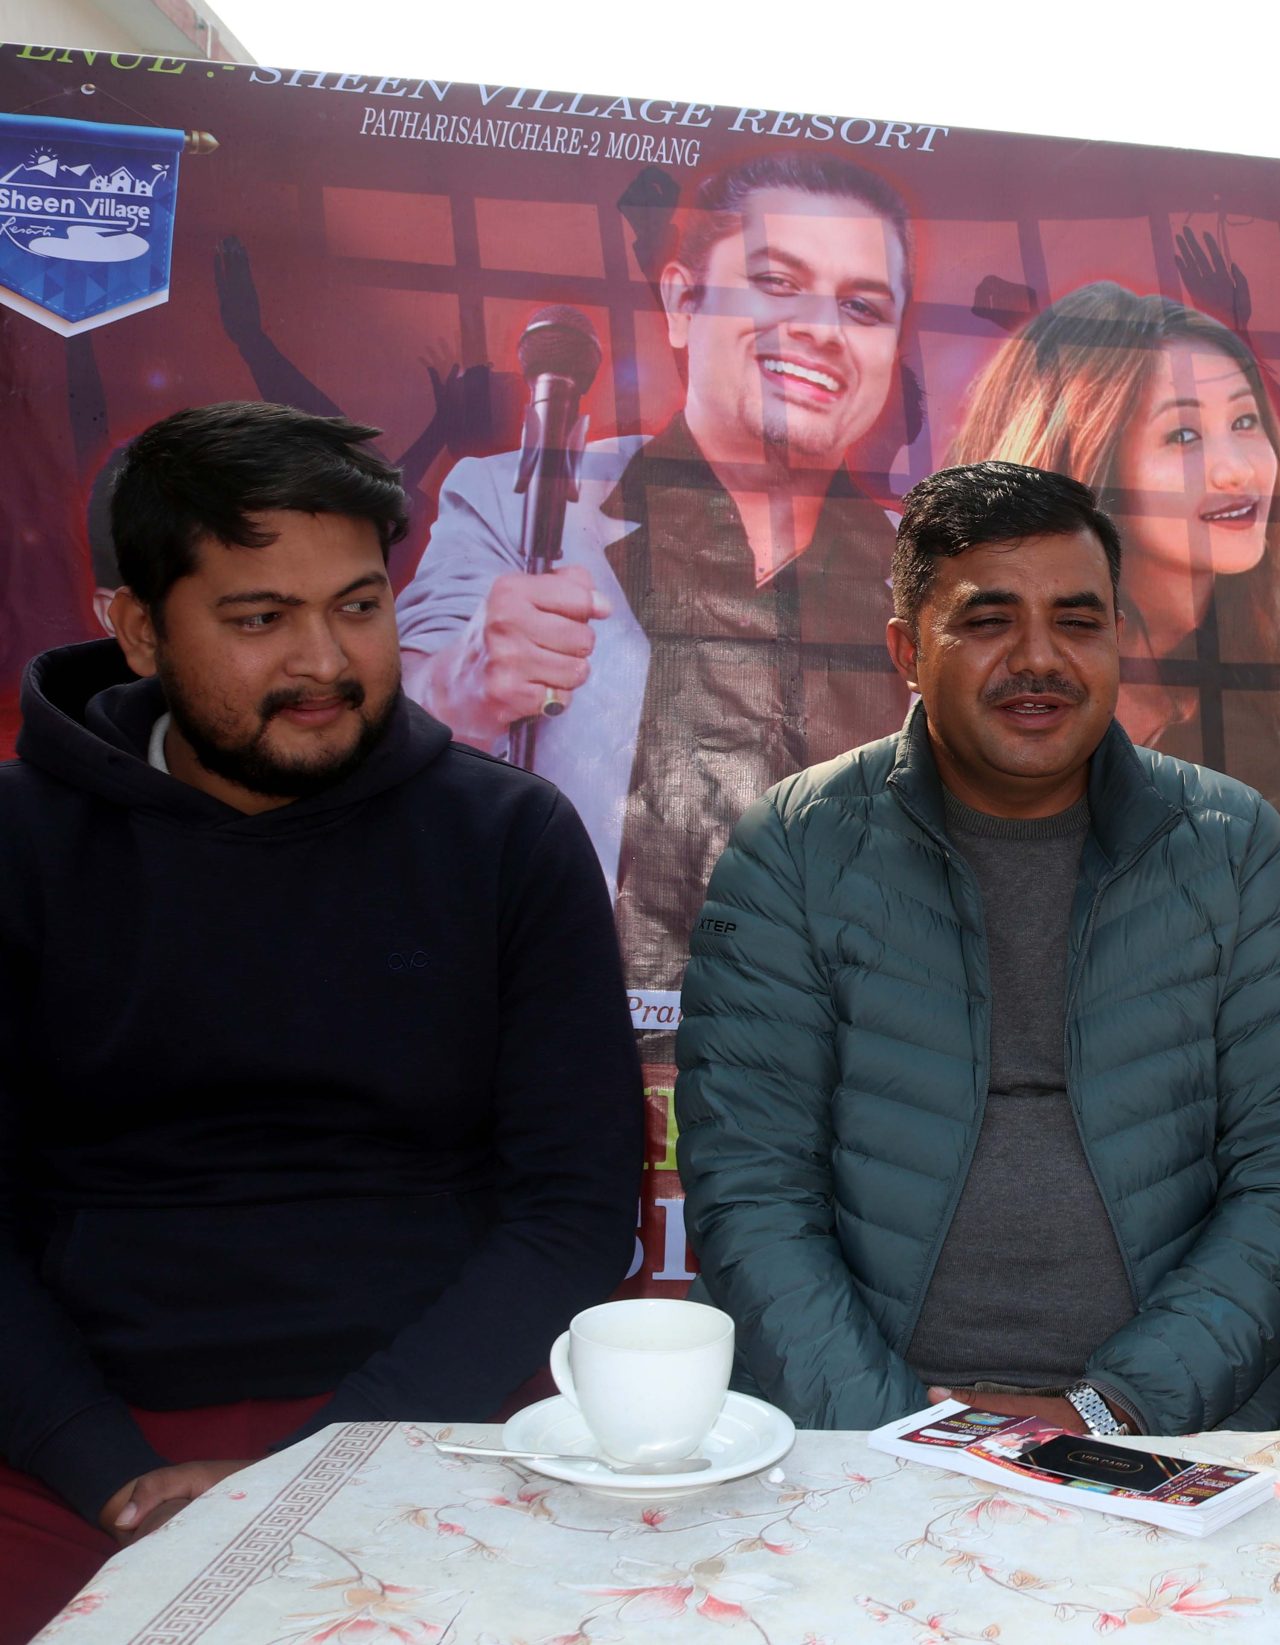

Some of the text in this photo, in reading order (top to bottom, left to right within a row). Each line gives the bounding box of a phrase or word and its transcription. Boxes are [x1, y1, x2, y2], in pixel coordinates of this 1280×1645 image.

[0, 43, 186, 75] ENUE
[249, 67, 453, 101] SHEEN
[478, 84, 715, 128] VILLAGE
[728, 108, 949, 152] RESORT
[360, 107, 700, 167] PATHARISANICHARE-2 MORANG
[0, 188, 150, 232] Sheen Village
[628, 996, 684, 1024] Pra
